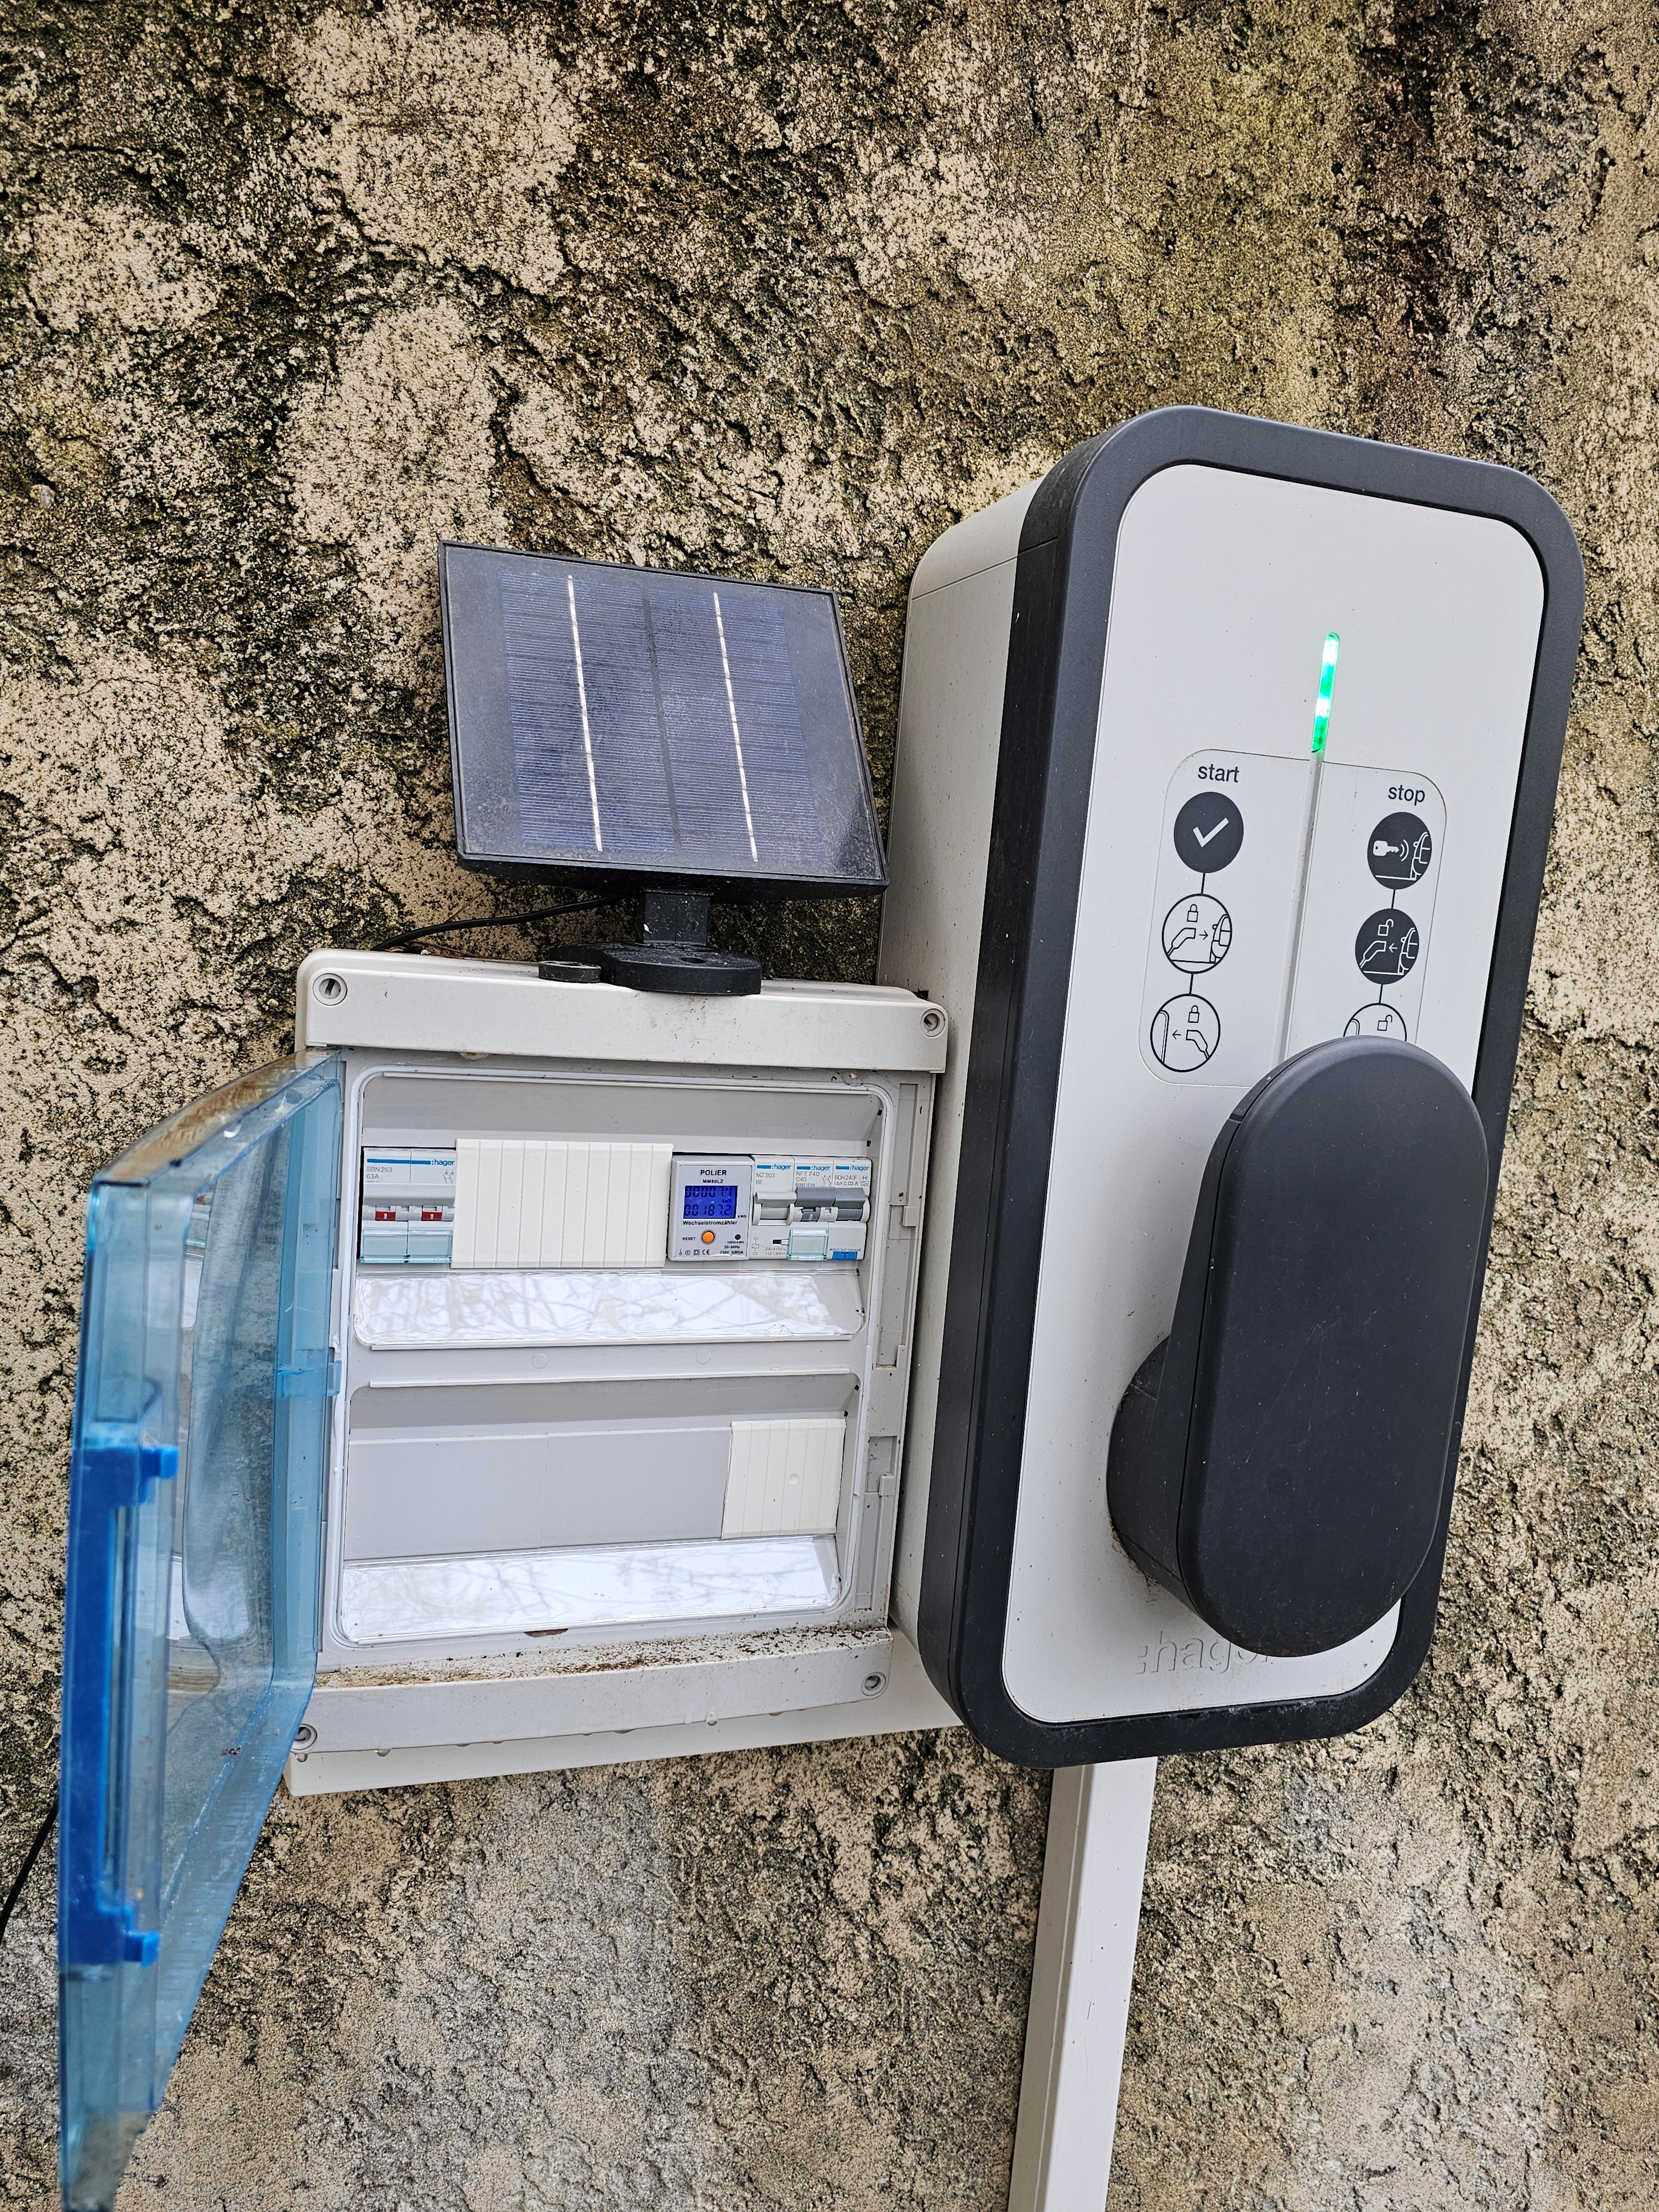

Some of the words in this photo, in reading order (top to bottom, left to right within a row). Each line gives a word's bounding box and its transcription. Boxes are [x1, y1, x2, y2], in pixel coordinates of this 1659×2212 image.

[1198, 764, 1239, 782] start
[1388, 785, 1425, 806] stop
[1135, 1631, 1269, 1674] :hag
